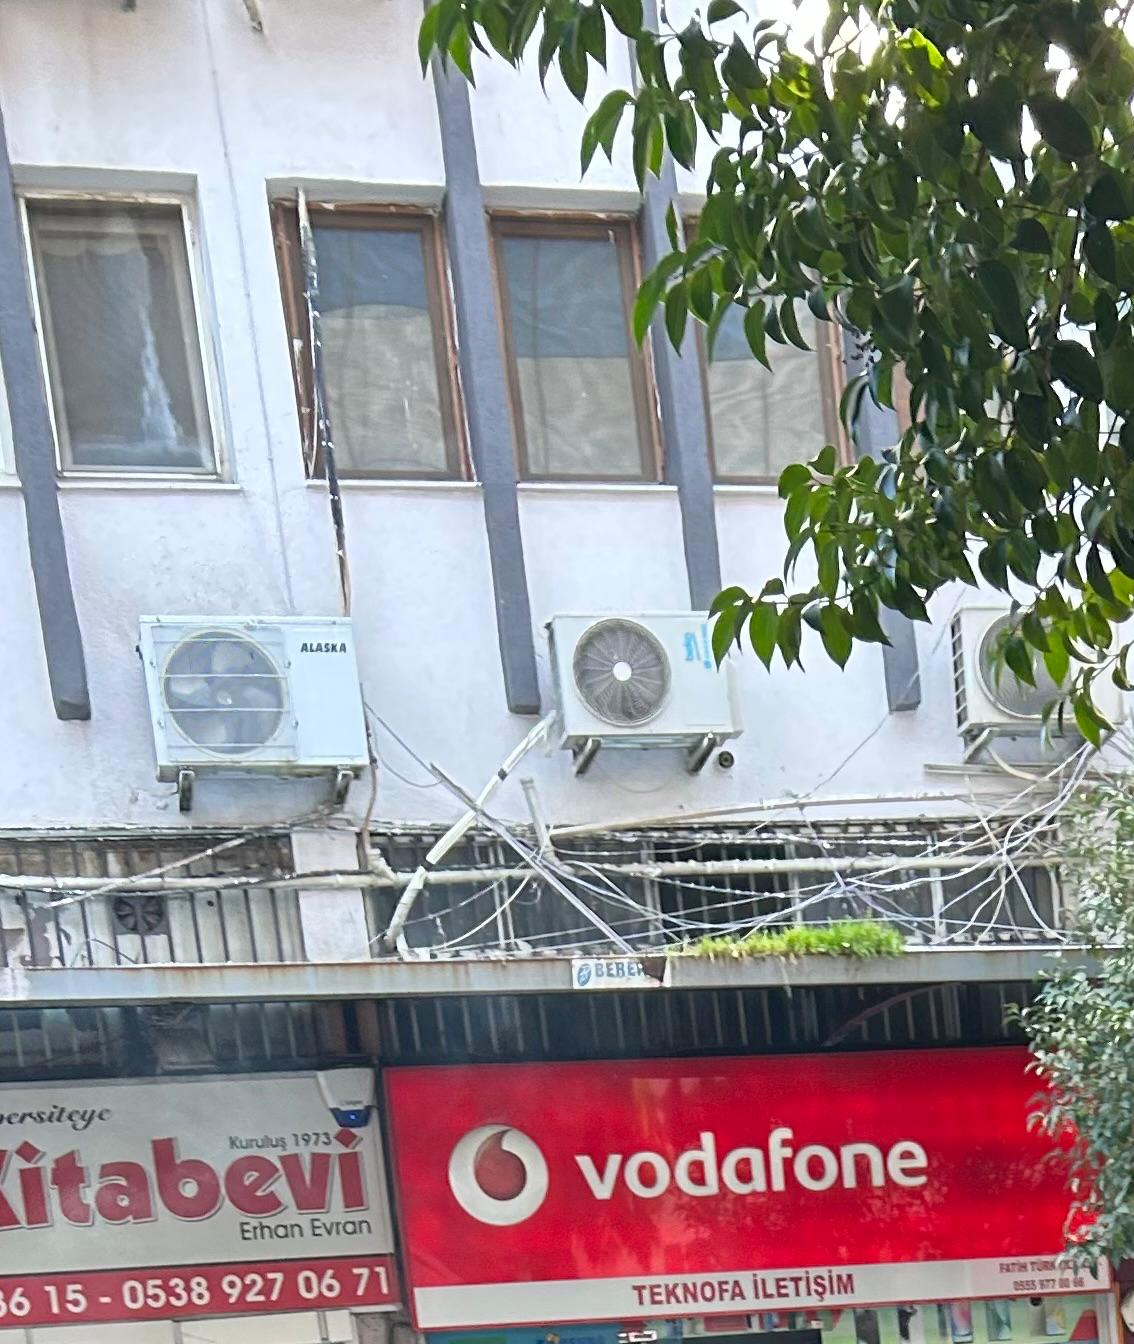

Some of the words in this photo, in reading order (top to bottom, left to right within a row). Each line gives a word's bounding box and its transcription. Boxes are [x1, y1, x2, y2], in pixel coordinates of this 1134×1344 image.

[300, 642, 347, 653] ALASKA
[228, 1133, 287, 1152] Kuruluş
[292, 1131, 332, 1148] 1973
[574, 1126, 929, 1201] vodafone
[239, 1219, 304, 1242] Erhan
[311, 1216, 372, 1238] Evran
[43, 1283, 88, 1314] 15
[121, 1274, 211, 1310] 0538
[221, 1271, 285, 1304] 927
[296, 1266, 341, 1300] 06
[351, 1265, 389, 1295] 71
[632, 1279, 747, 1307] TEKNOFA
[751, 1269, 856, 1302] İLETİŞİM
